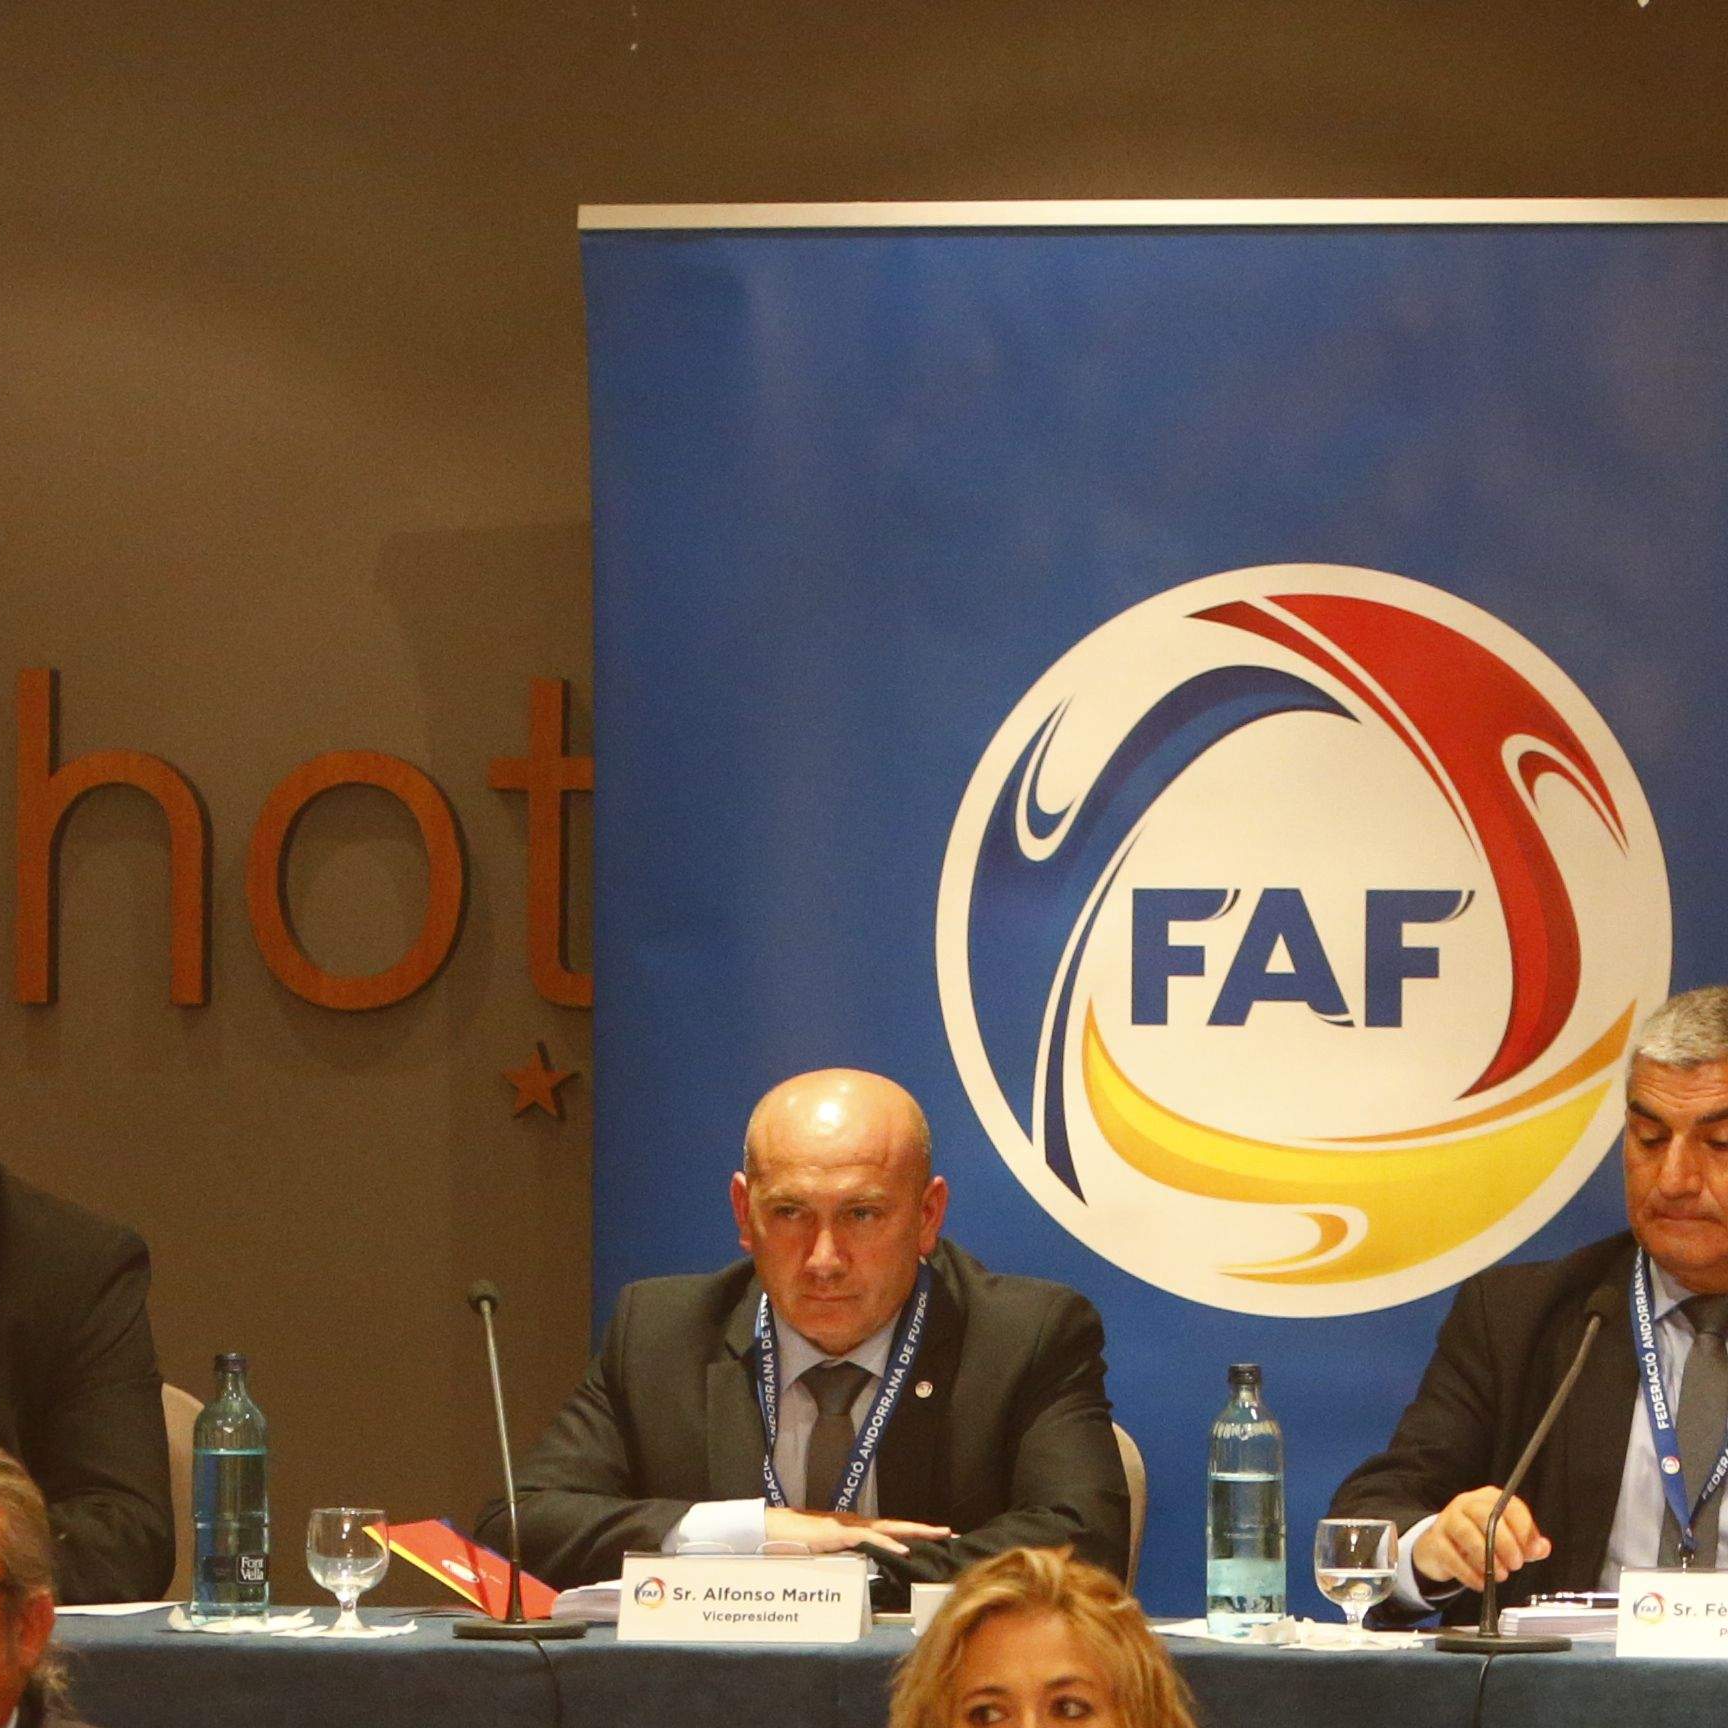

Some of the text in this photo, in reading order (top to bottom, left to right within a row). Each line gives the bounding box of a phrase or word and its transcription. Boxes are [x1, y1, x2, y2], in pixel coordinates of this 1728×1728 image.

[1130, 886, 1476, 1029] FAF
[761, 1328, 773, 1350] DE
[858, 1367, 907, 1460] ANDORRANA
[898, 1344, 915, 1364] DE
[907, 1291, 930, 1344] FUTBOL
[1642, 1351, 1671, 1431] FEDERACIÓ
[673, 1587, 696, 1601] Sr.
[703, 1587, 776, 1602] Alfonso
[702, 1610, 800, 1624] Vicepresident
[1673, 1603, 1697, 1617] Sr.
